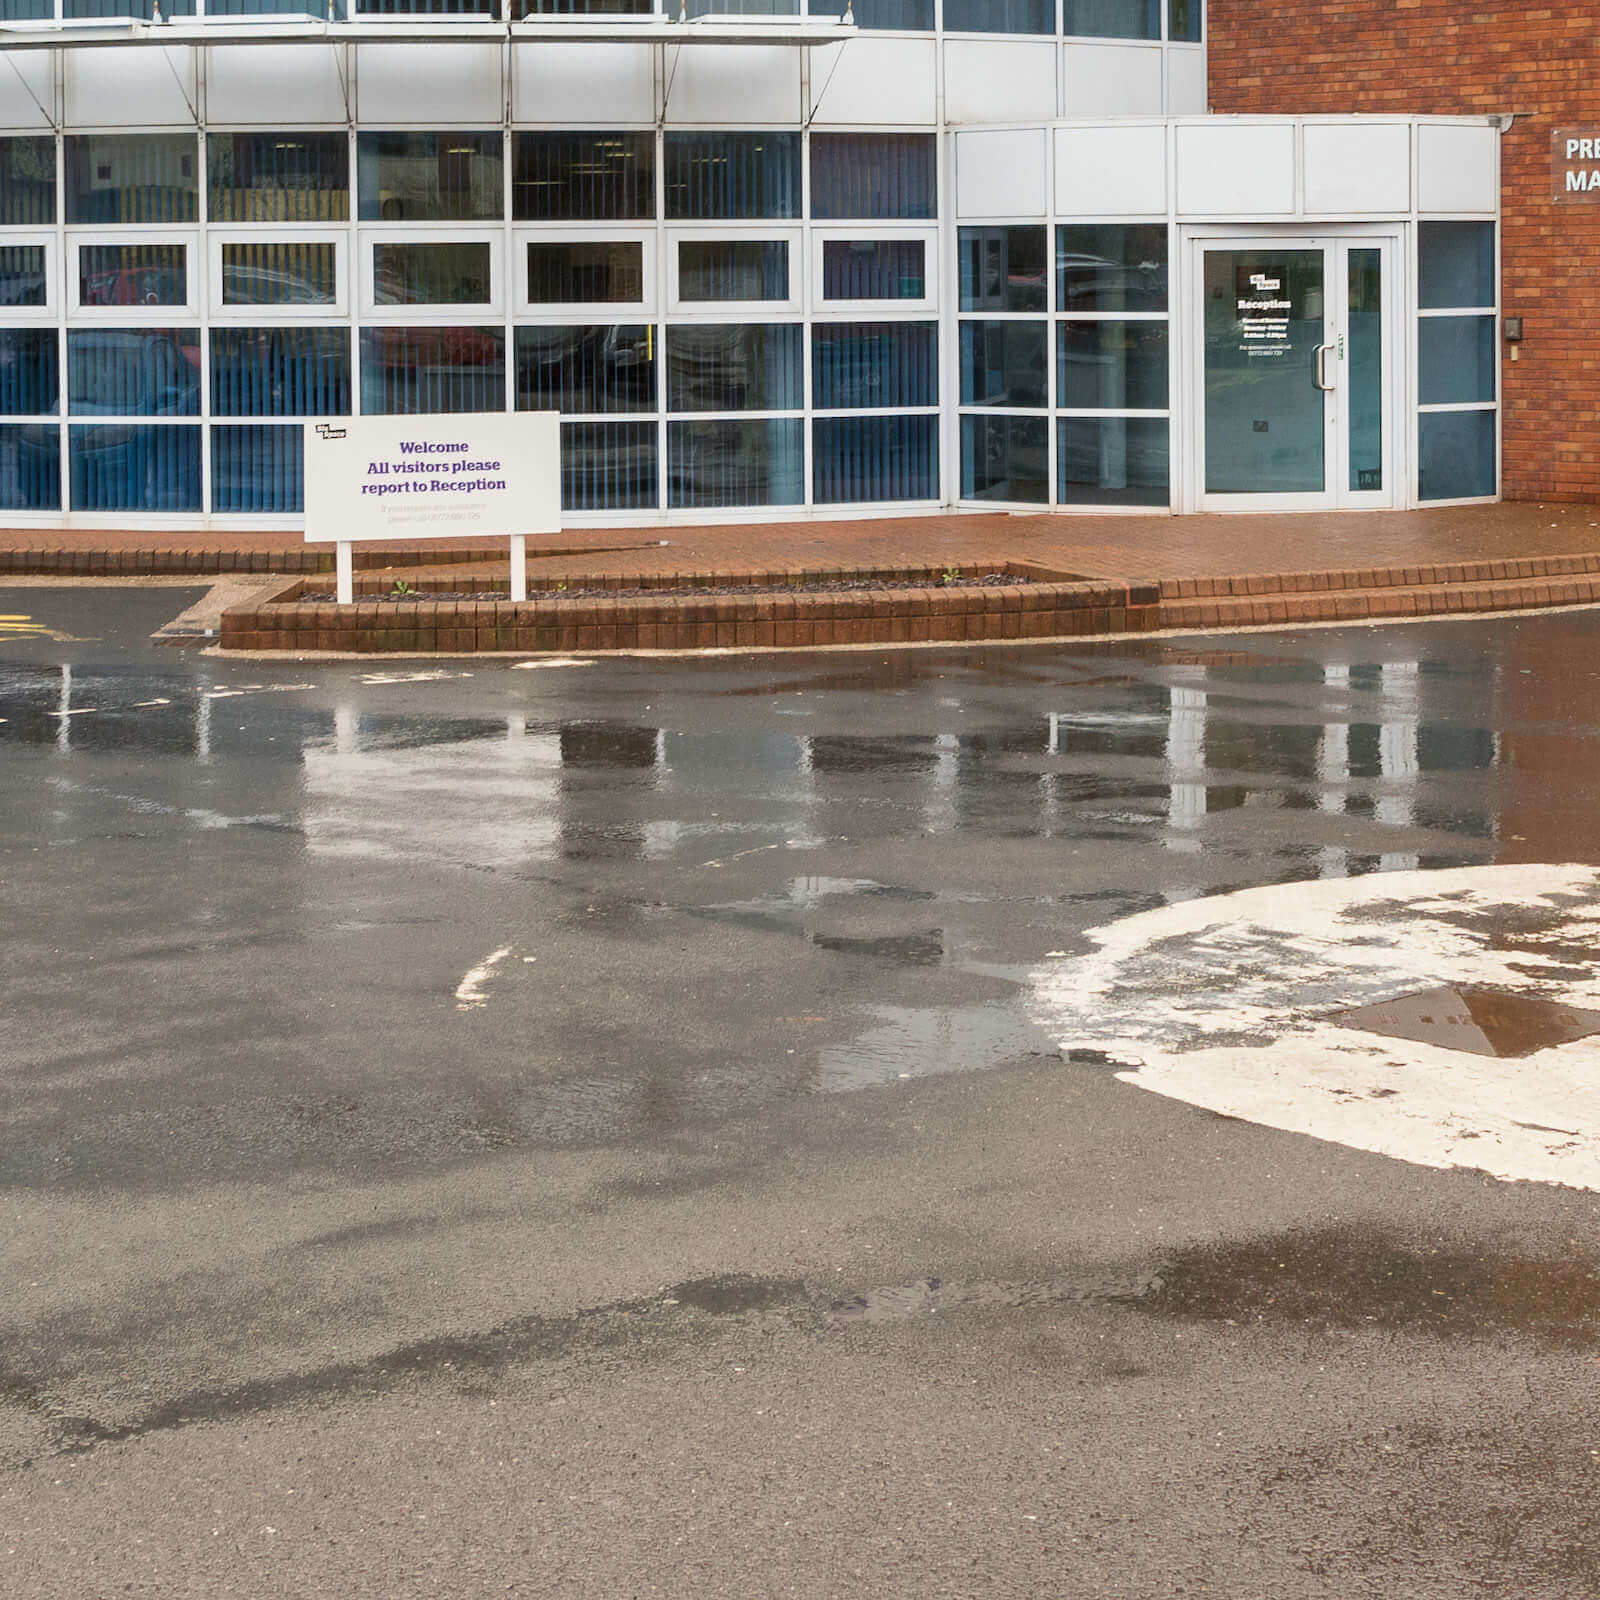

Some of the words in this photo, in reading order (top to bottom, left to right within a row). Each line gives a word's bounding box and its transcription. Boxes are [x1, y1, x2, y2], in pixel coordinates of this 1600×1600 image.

[400, 441, 469, 454] Welcome
[367, 462, 389, 475] All
[392, 461, 449, 474] visitors
[452, 460, 501, 473] please
[361, 482, 410, 496] report
[413, 481, 427, 493] to
[430, 478, 506, 495] Reception
